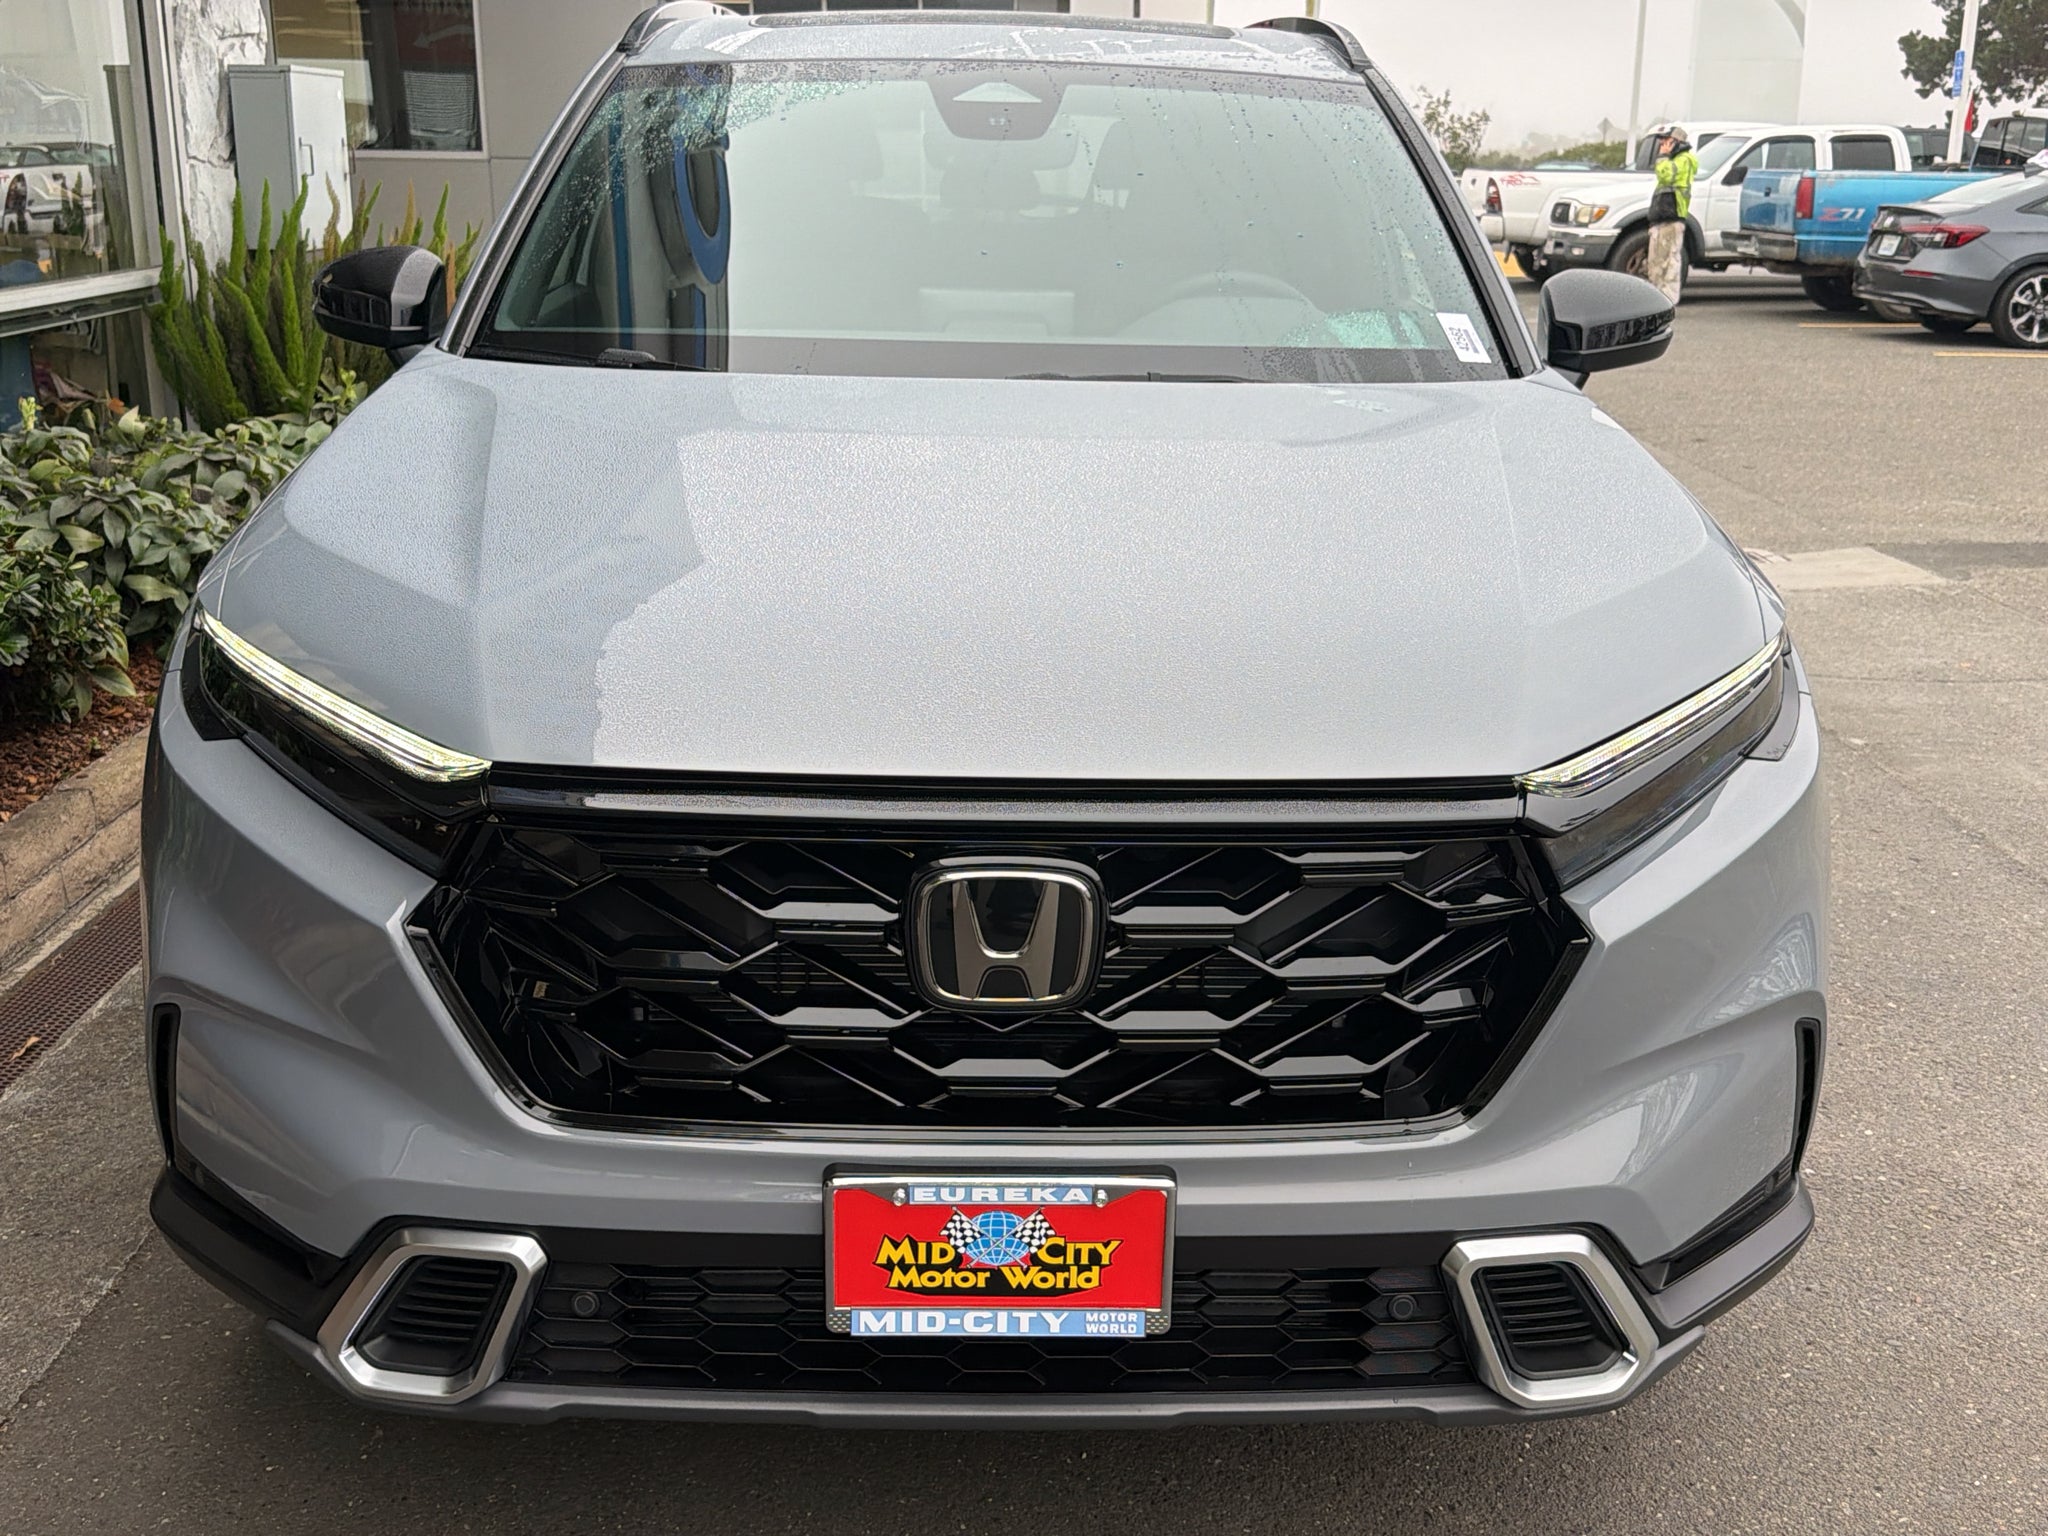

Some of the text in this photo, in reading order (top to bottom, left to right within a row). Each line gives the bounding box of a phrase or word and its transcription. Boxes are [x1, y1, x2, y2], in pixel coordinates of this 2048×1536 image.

[1818, 207, 1866, 221] Z71
[912, 1187, 1090, 1202] EUREKA
[876, 1236, 1123, 1265] MID CITY
[889, 1265, 1100, 1289] Motor World
[858, 1311, 1070, 1333] MID-CITY
[1085, 1312, 1138, 1323] MOTOR
[1085, 1323, 1138, 1334] WORLD
